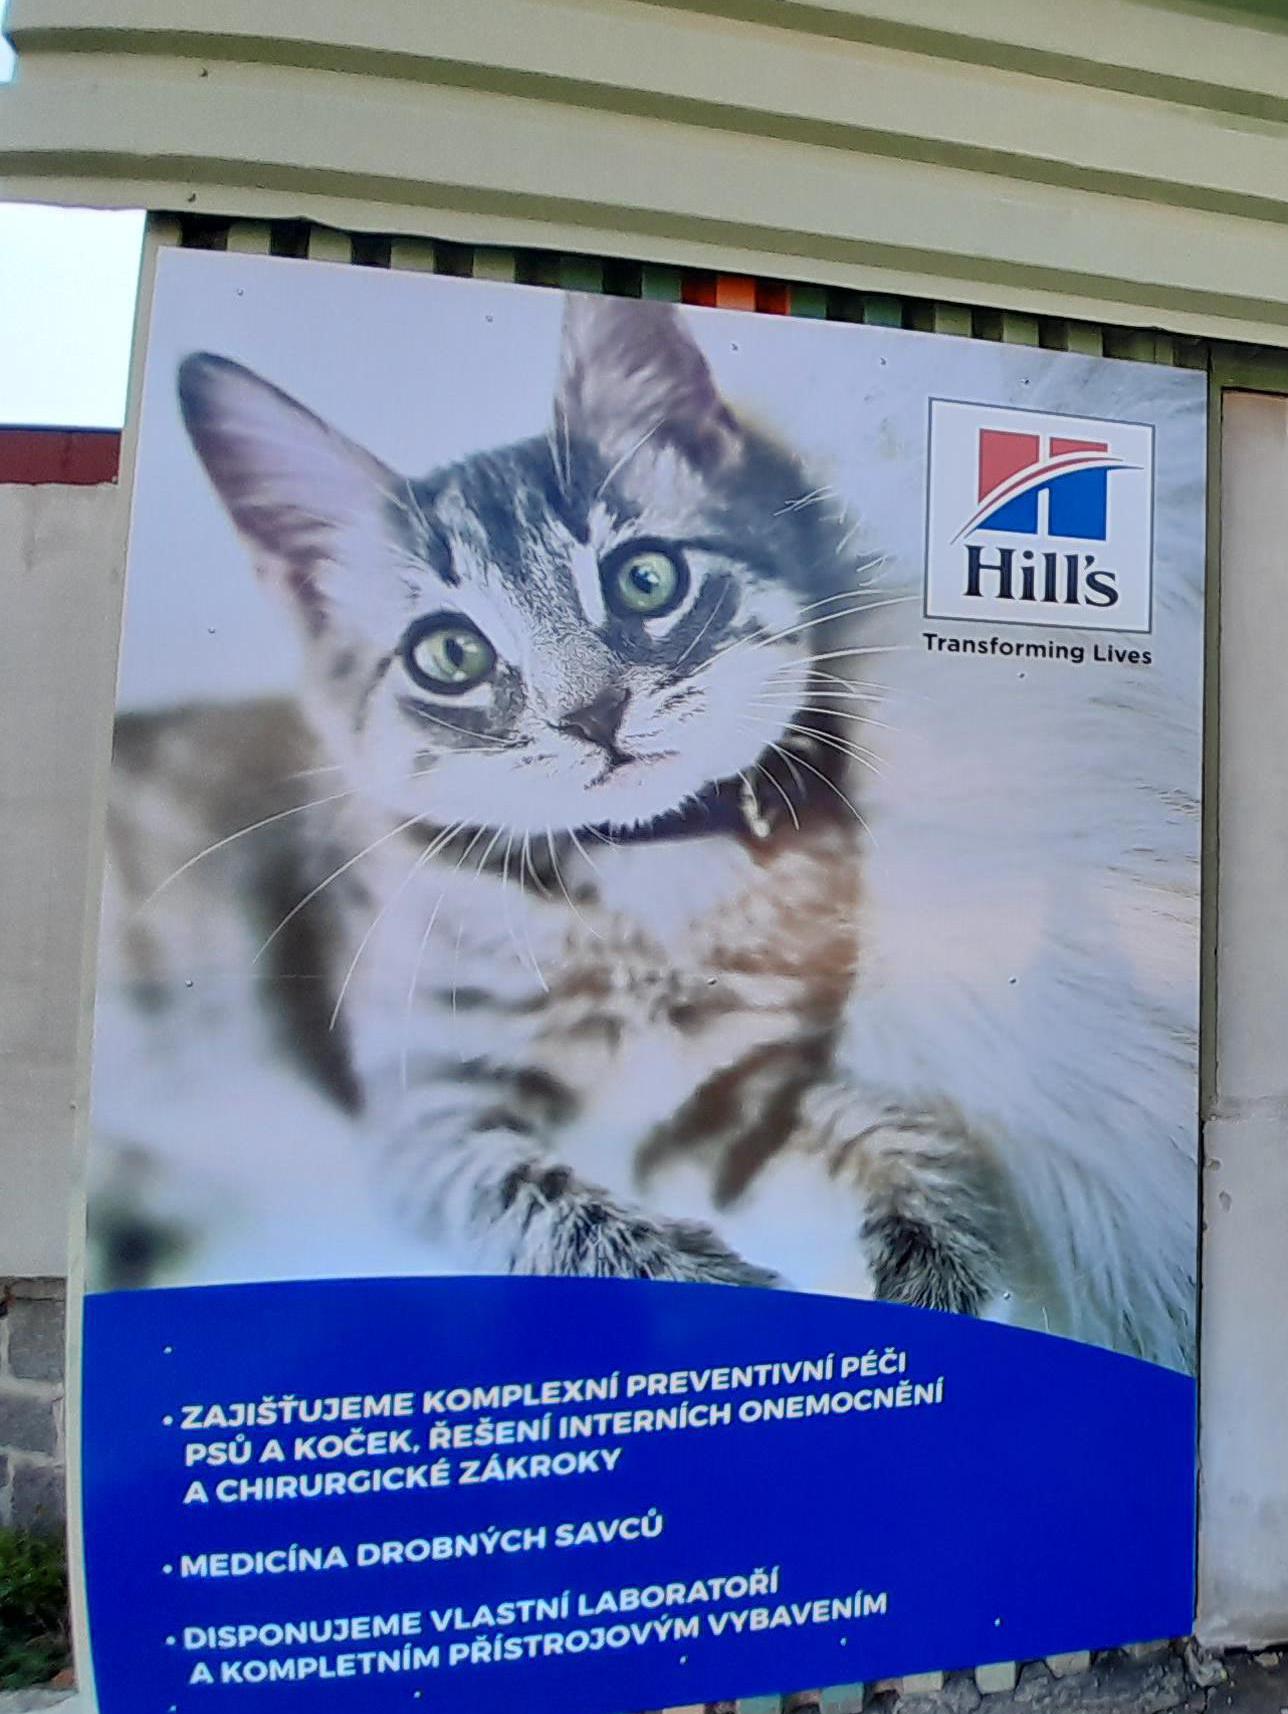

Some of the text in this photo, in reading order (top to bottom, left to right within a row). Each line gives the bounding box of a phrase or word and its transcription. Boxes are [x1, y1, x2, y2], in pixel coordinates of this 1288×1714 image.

[963, 544, 1119, 608] Hill's
[923, 632, 1153, 665] Transforming Lives
[181, 1347, 907, 1430] ZAJIŠŤUJEME KOMPLEXNÍ PREVENTIVNÍ PÉČI
[185, 1376, 945, 1467] PSŮ A KOČEK, ŘEŠENÍ INTERNÍCH ONEMOCNĚNÍ
[183, 1447, 623, 1504] A CHIRURGICKÉ ZÁKROKY
[180, 1507, 664, 1578] MEDICÍNA DROBNÝCH SAVCŮ
[183, 1565, 781, 1651] DISPONUJEME VLASTNÍ LABORATOŘÍ
[189, 1590, 889, 1685] A KOMPLETNÍM PŘÍSTROJOVÝM VYBAVENÍM
